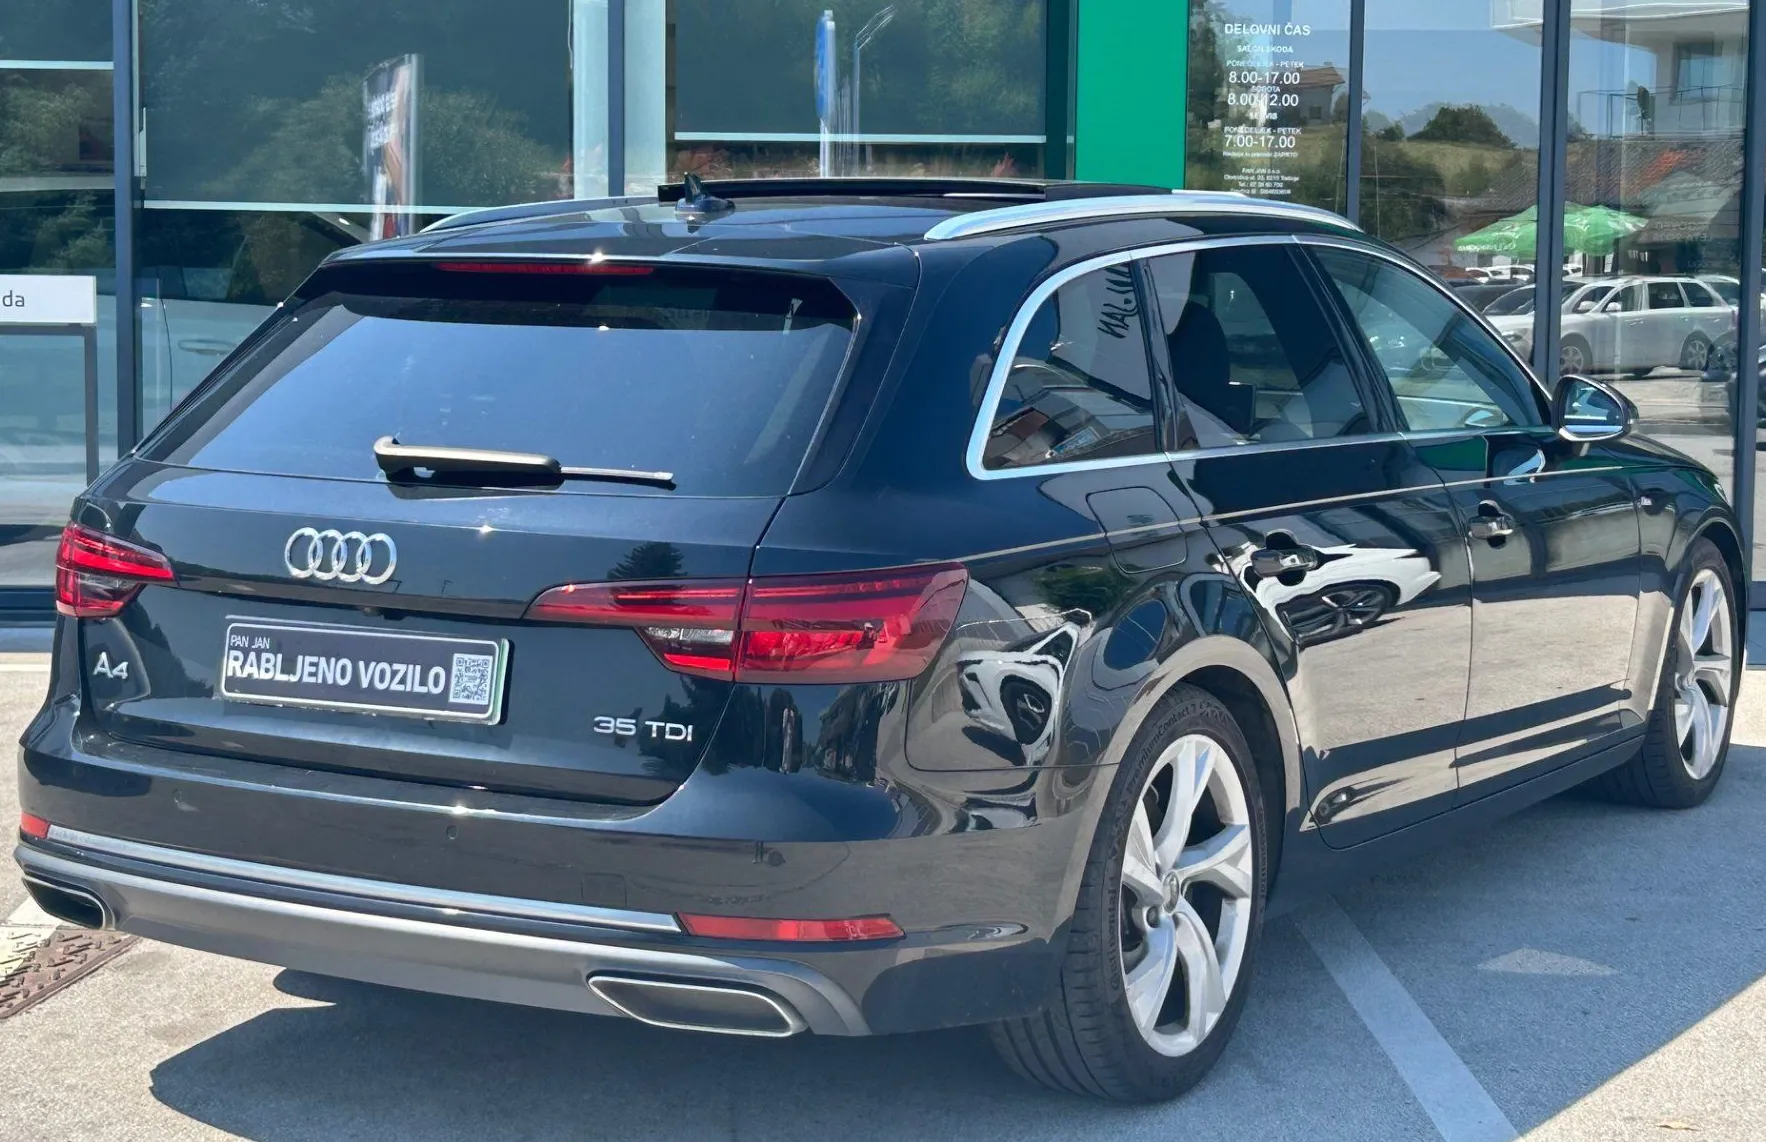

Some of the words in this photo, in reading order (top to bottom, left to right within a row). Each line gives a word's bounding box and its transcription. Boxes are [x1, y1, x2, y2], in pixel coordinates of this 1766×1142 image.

[1224, 23, 1280, 35] DELOVNI
[1284, 22, 1311, 36] ČAS
[1228, 71, 1300, 85] 8.00-17.00
[1249, 112, 1278, 120] SEVIS
[1224, 134, 1295, 148] 7.00-17.00
[230, 634, 249, 648] PAN
[251, 636, 270, 649] JAN
[93, 651, 129, 680] A4
[226, 649, 352, 687] RABLJENO
[357, 660, 446, 696] VOZILO
[593, 716, 637, 736] 35
[644, 720, 694, 742] TDI
